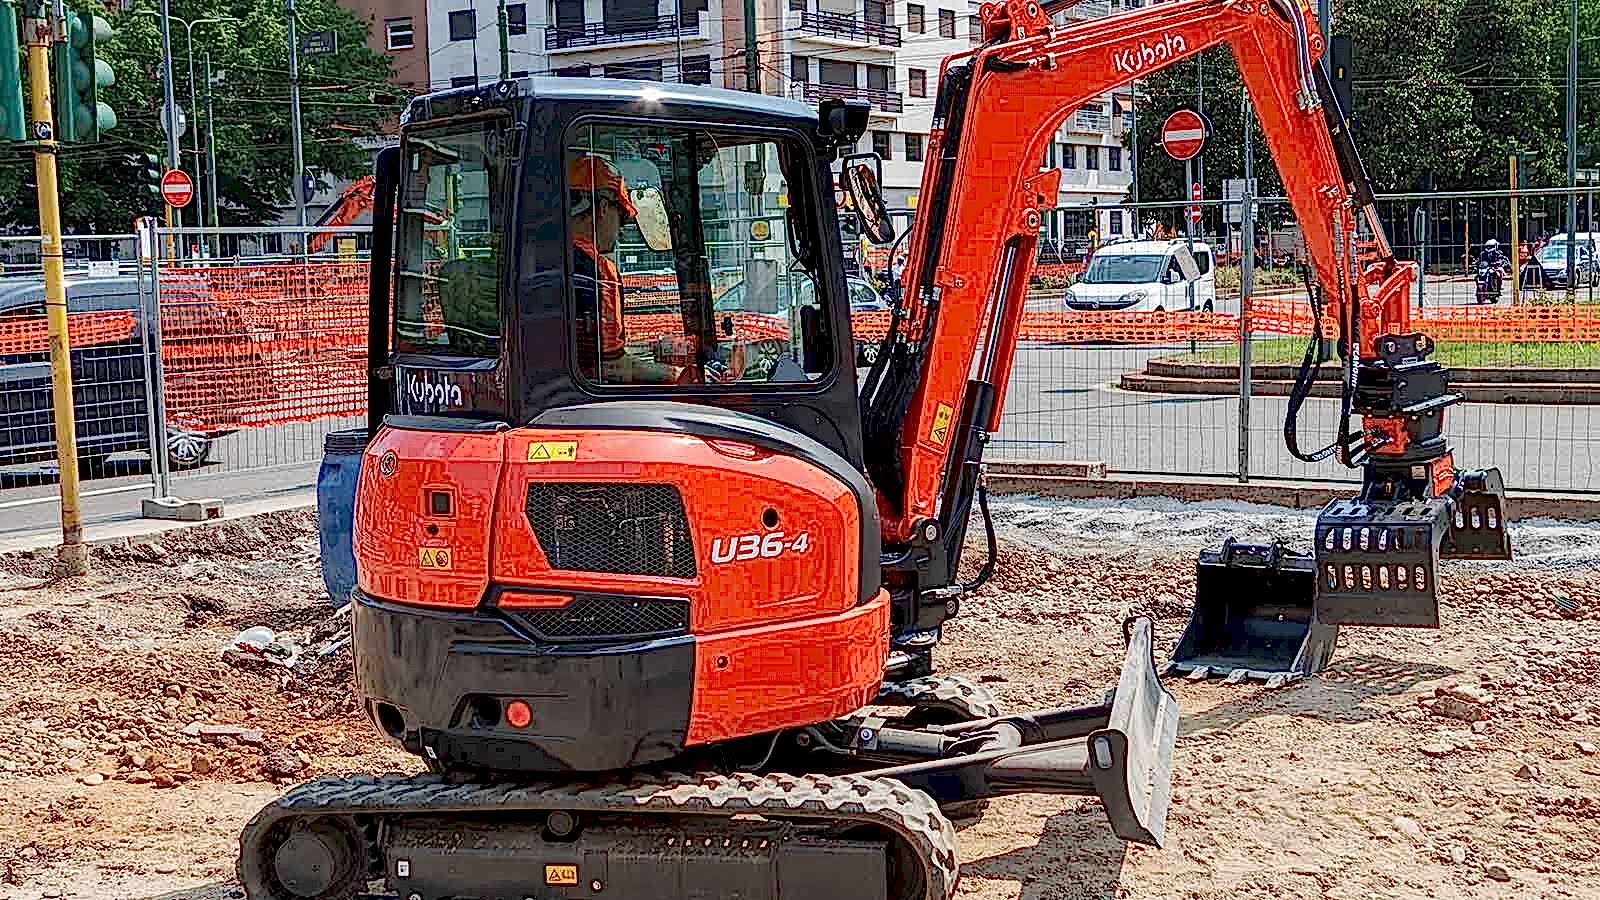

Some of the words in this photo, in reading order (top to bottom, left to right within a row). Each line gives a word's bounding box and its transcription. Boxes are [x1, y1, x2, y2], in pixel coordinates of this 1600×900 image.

[1114, 32, 1186, 73] Kubota
[407, 373, 463, 406] Kubota
[711, 531, 809, 563] U36-4
